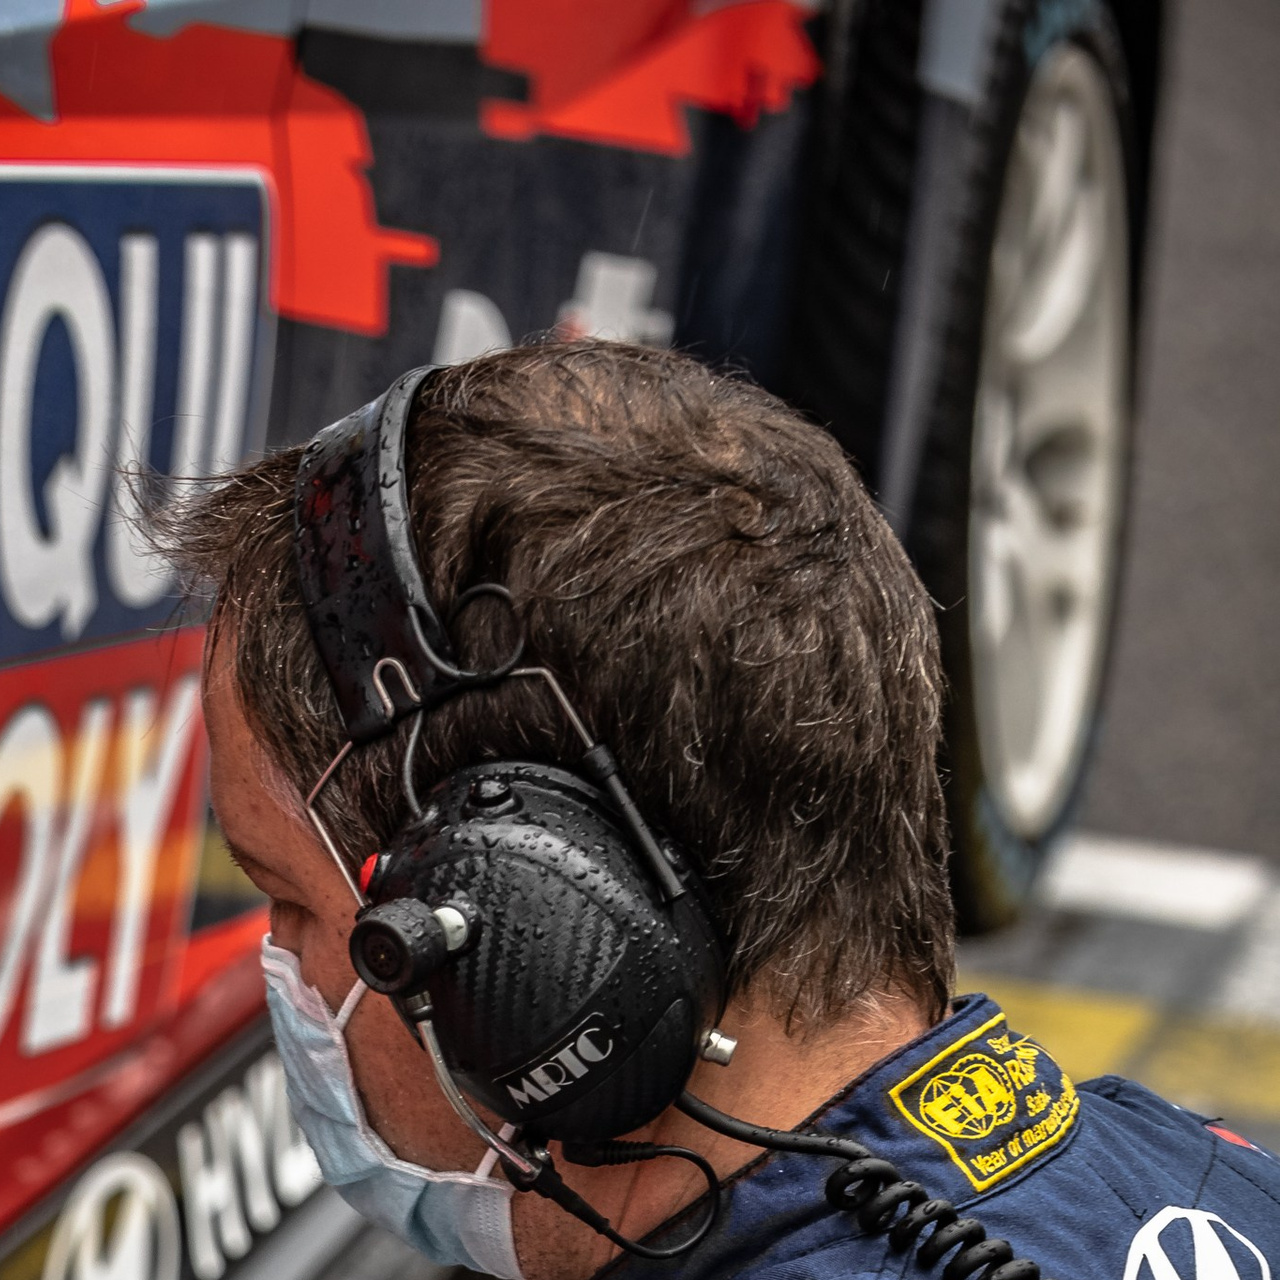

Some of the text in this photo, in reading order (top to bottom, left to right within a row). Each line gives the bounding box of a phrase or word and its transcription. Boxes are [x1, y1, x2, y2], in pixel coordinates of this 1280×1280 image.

[505, 1027, 614, 1110] MRTC
[922, 1066, 1015, 1136] FIA
[970, 1147, 1007, 1176] Year
[1007, 1132, 1024, 1158] of
